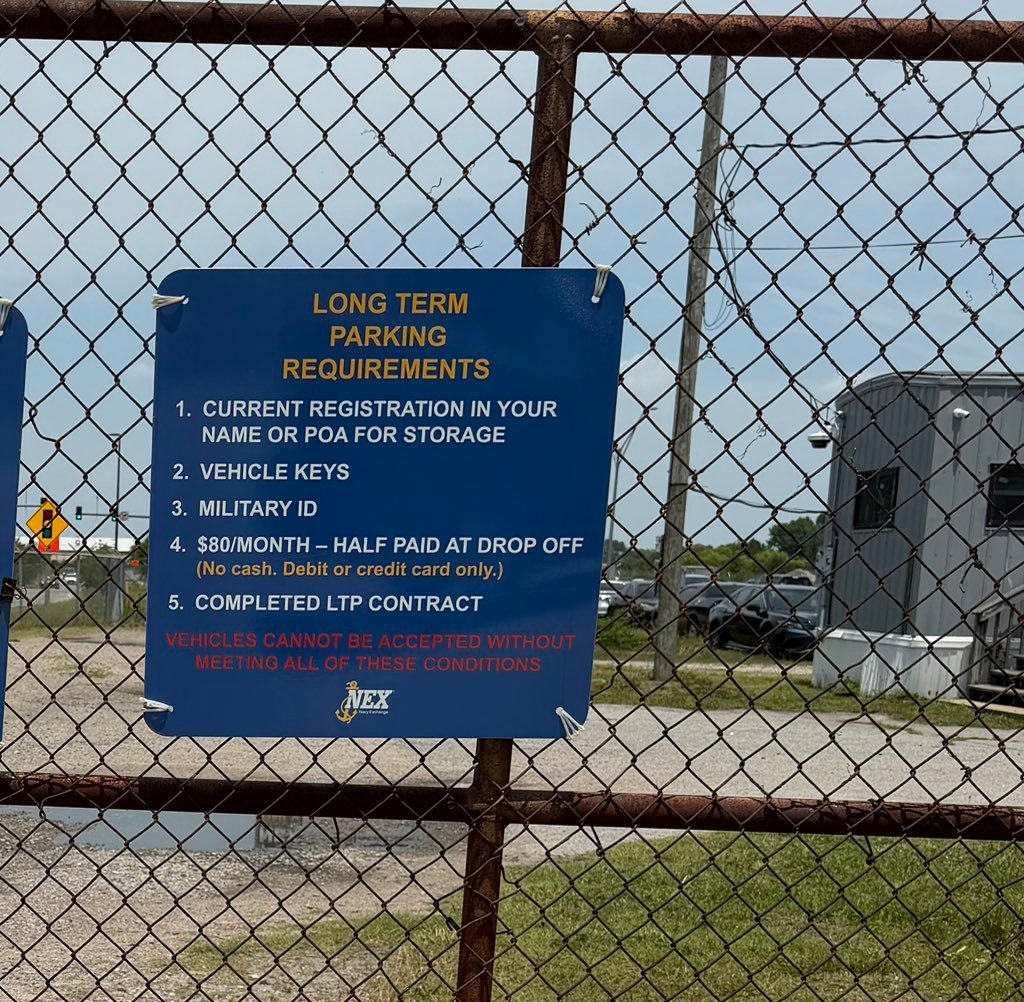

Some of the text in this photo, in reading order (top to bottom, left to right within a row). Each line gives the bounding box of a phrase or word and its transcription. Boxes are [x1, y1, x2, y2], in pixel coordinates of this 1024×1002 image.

[313, 292, 468, 314] LONG TERM
[330, 325, 447, 347] PARKING
[283, 358, 490, 381] REQUIREMENTS
[176, 399, 557, 418] 1. CURRENT REGISTRATION IN YOUR
[202, 426, 506, 443] NAME OR POA FOR STORAGE
[172, 463, 350, 481] 2. VEHICLE KEYS
[171, 499, 318, 517] 3. MILITARY ID
[169, 536, 186, 553] 4.
[197, 535, 310, 555] $80/MONTH
[333, 536, 388, 554] HALF
[393, 536, 441, 554] PAID
[444, 537, 472, 554] AT
[477, 537, 537, 554] DROP
[542, 537, 584, 554] OFF
[196, 560, 503, 580] (No cash. Debit or credit card only.)
[168, 594, 484, 612] 5. COMPLETED LTP CONTRACT
[166, 633, 576, 650] VEHICLES CANNOT BE ACCEPTED WITHOUT
[195, 655, 541, 672] MEETING ALL OF THESE CONDITIONS
[344, 689, 393, 710] NEX
